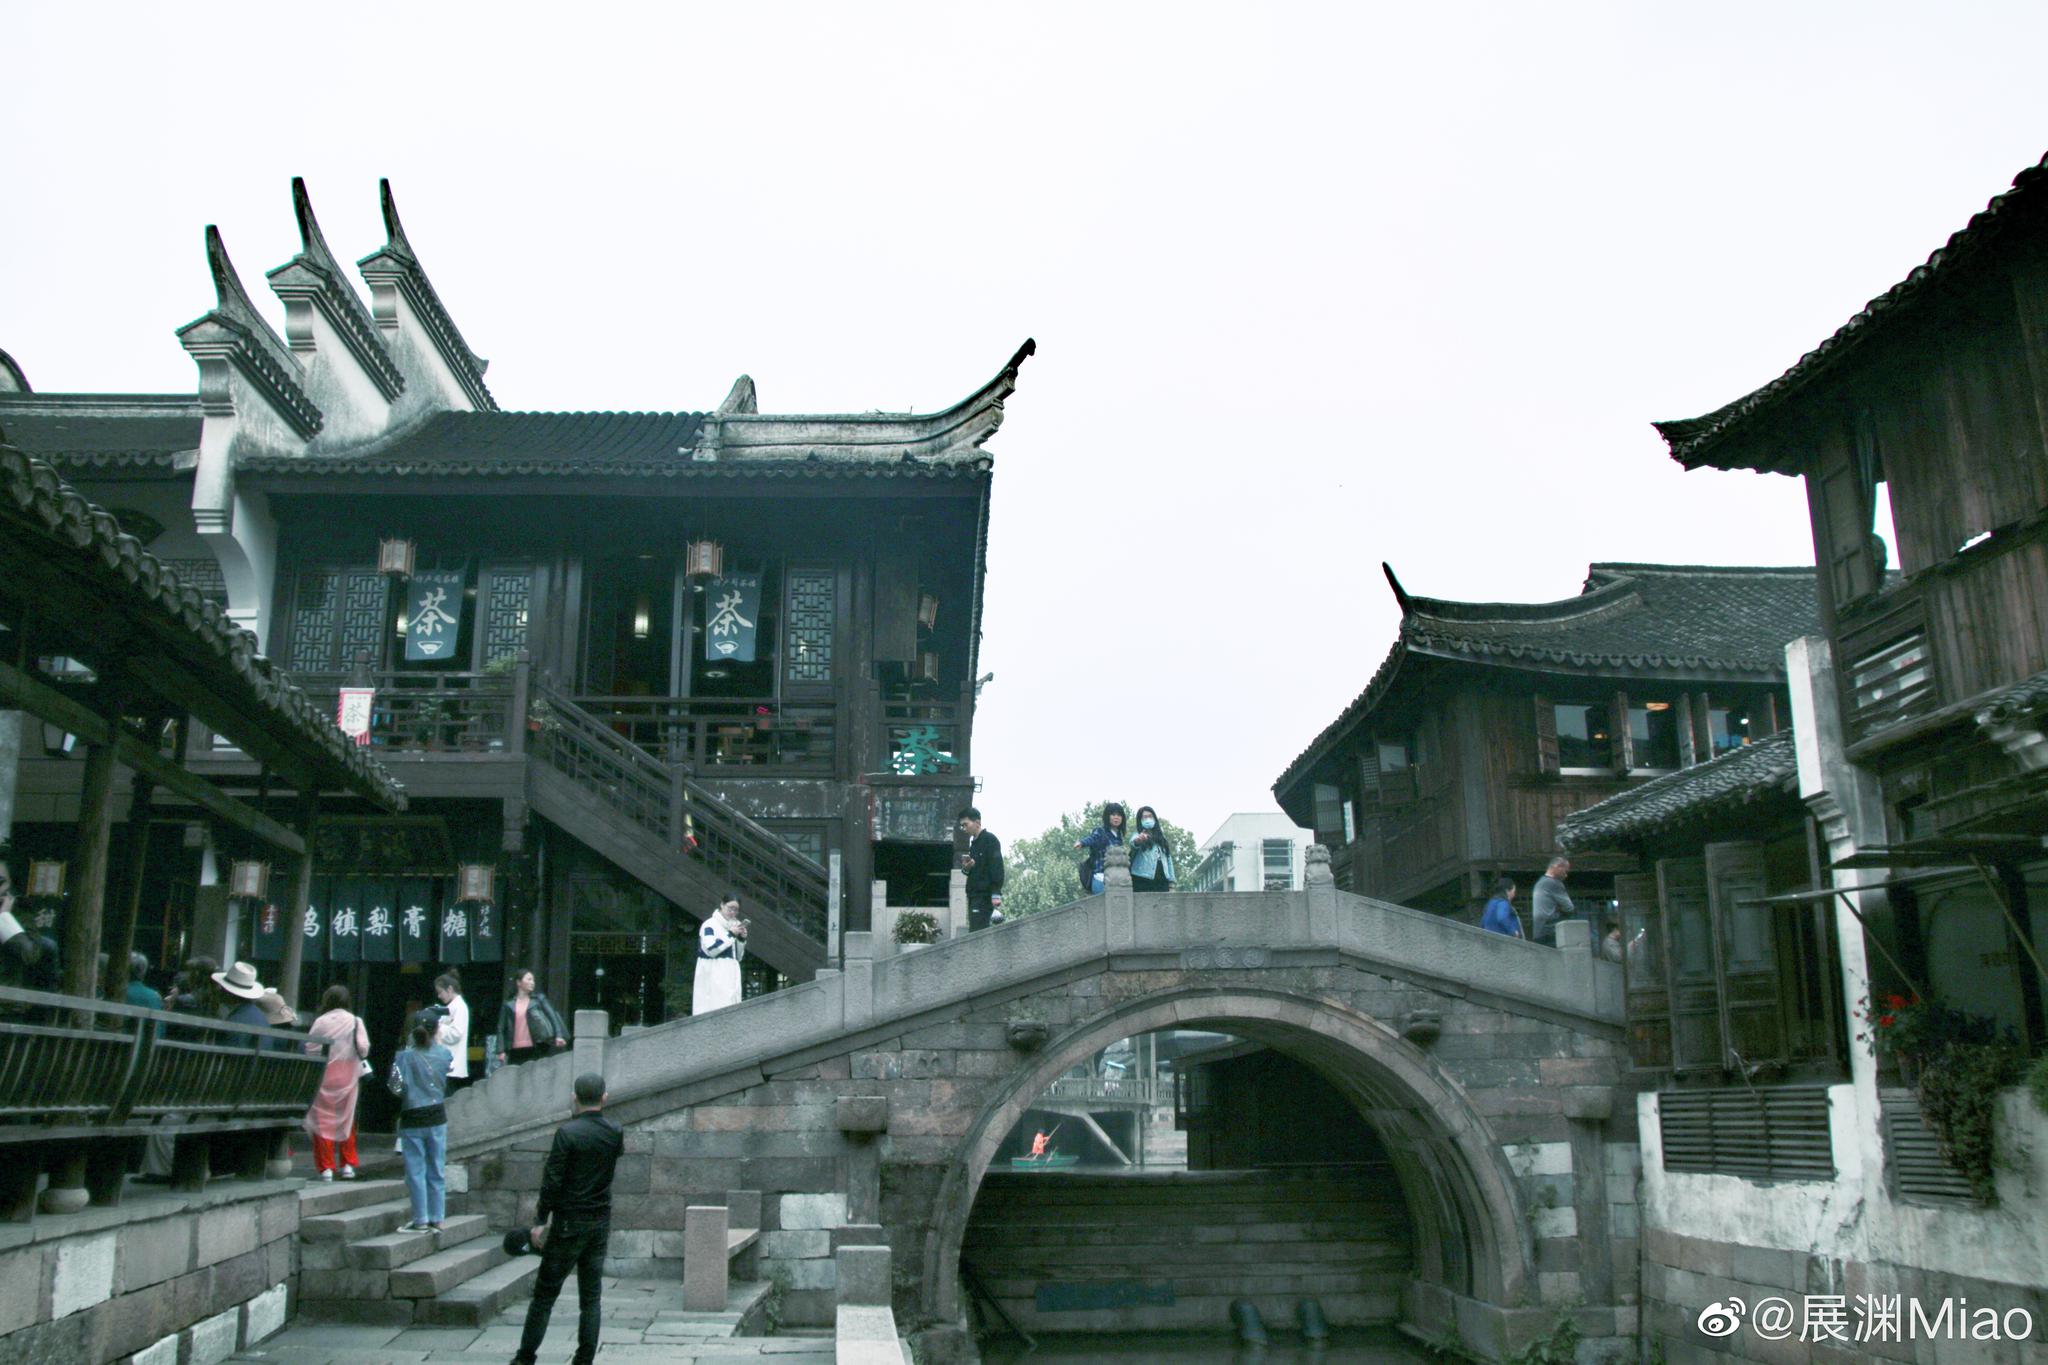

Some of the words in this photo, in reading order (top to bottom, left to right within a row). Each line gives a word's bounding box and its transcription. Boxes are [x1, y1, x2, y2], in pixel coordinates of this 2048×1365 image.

[408, 587, 457, 637] 茶
[708, 589, 754, 637] 茶
[881, 725, 960, 777] 茶
